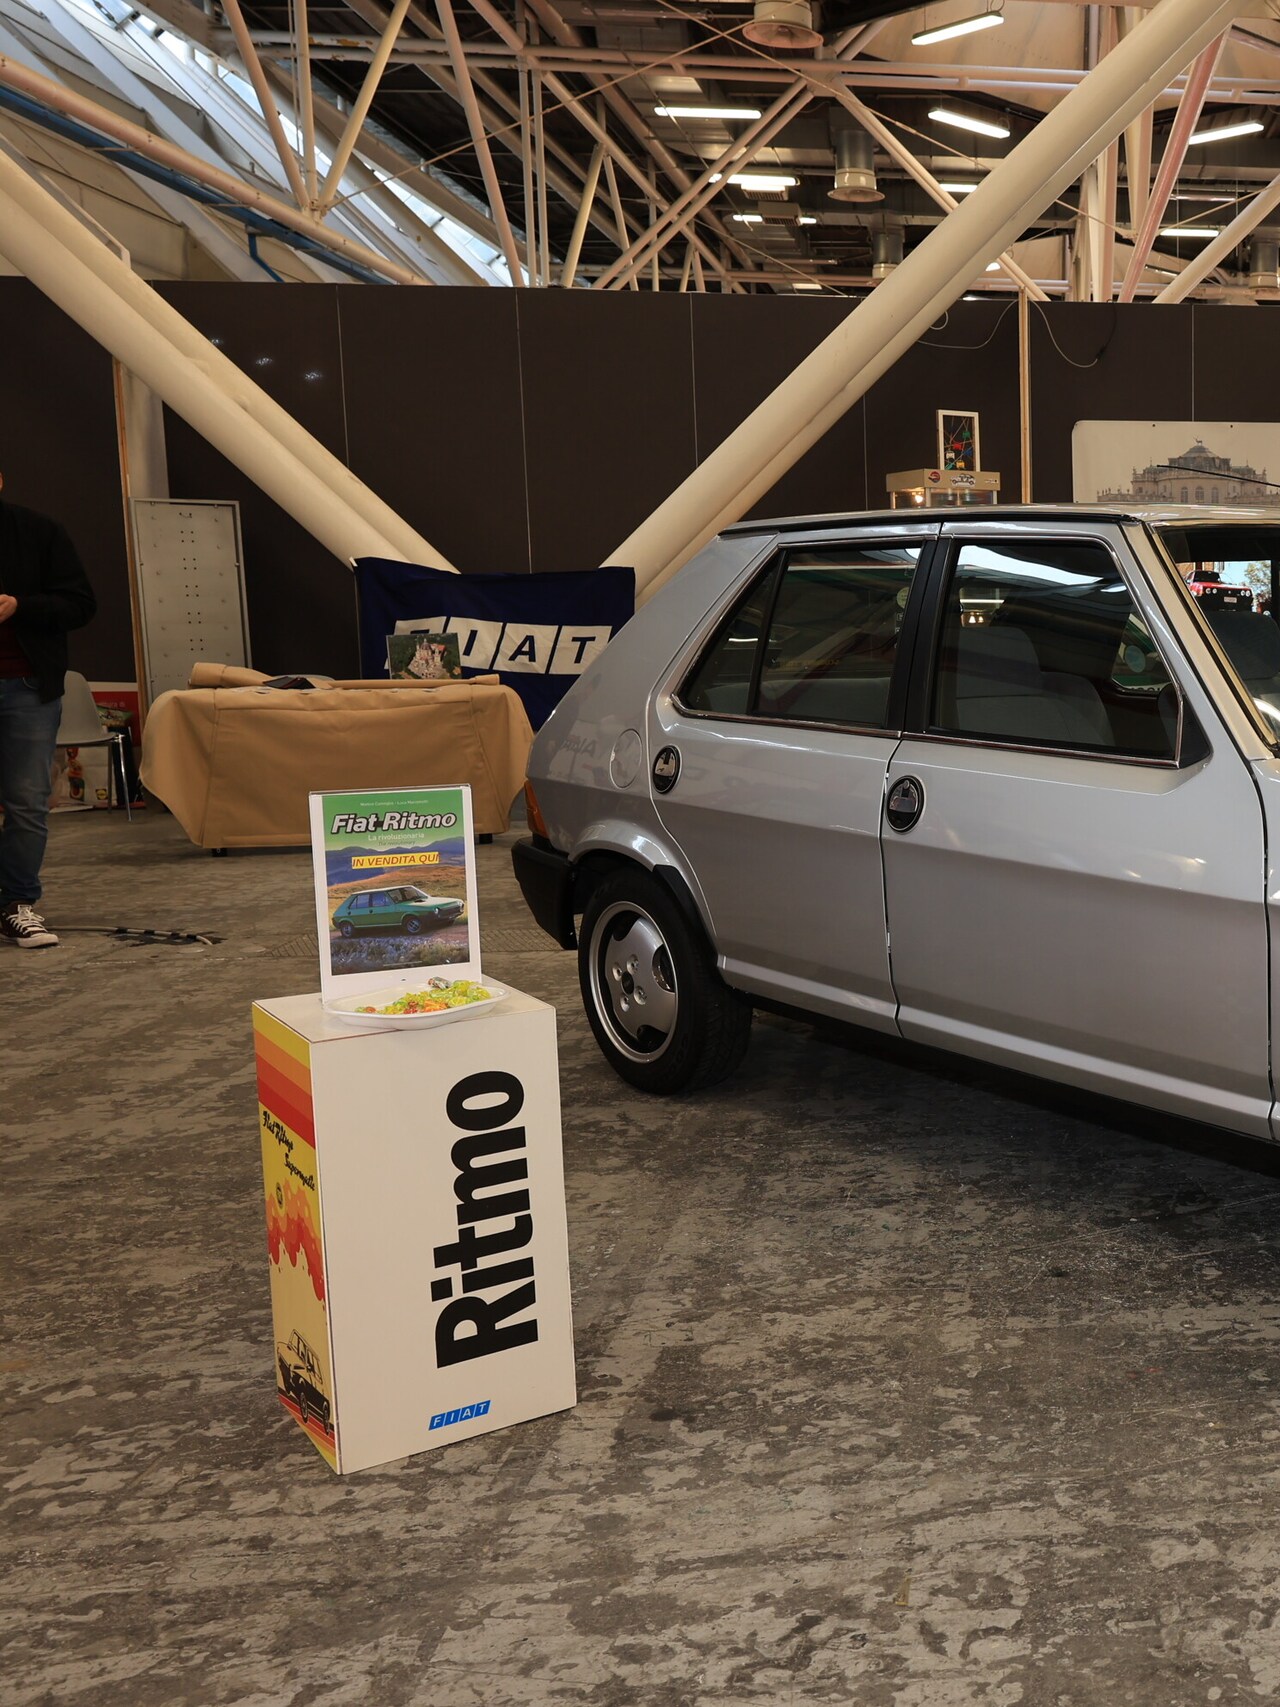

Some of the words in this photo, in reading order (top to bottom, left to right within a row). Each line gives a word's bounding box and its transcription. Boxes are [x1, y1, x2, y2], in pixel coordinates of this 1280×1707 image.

[331, 813, 377, 834] Fiat
[382, 811, 457, 831] Ritmo
[378, 832, 425, 841] rivoluzionaria
[352, 859, 364, 867] IN
[368, 856, 416, 867] VENDITA
[430, 1070, 538, 1368] Ritmo
[429, 1401, 490, 1429] FIAT
